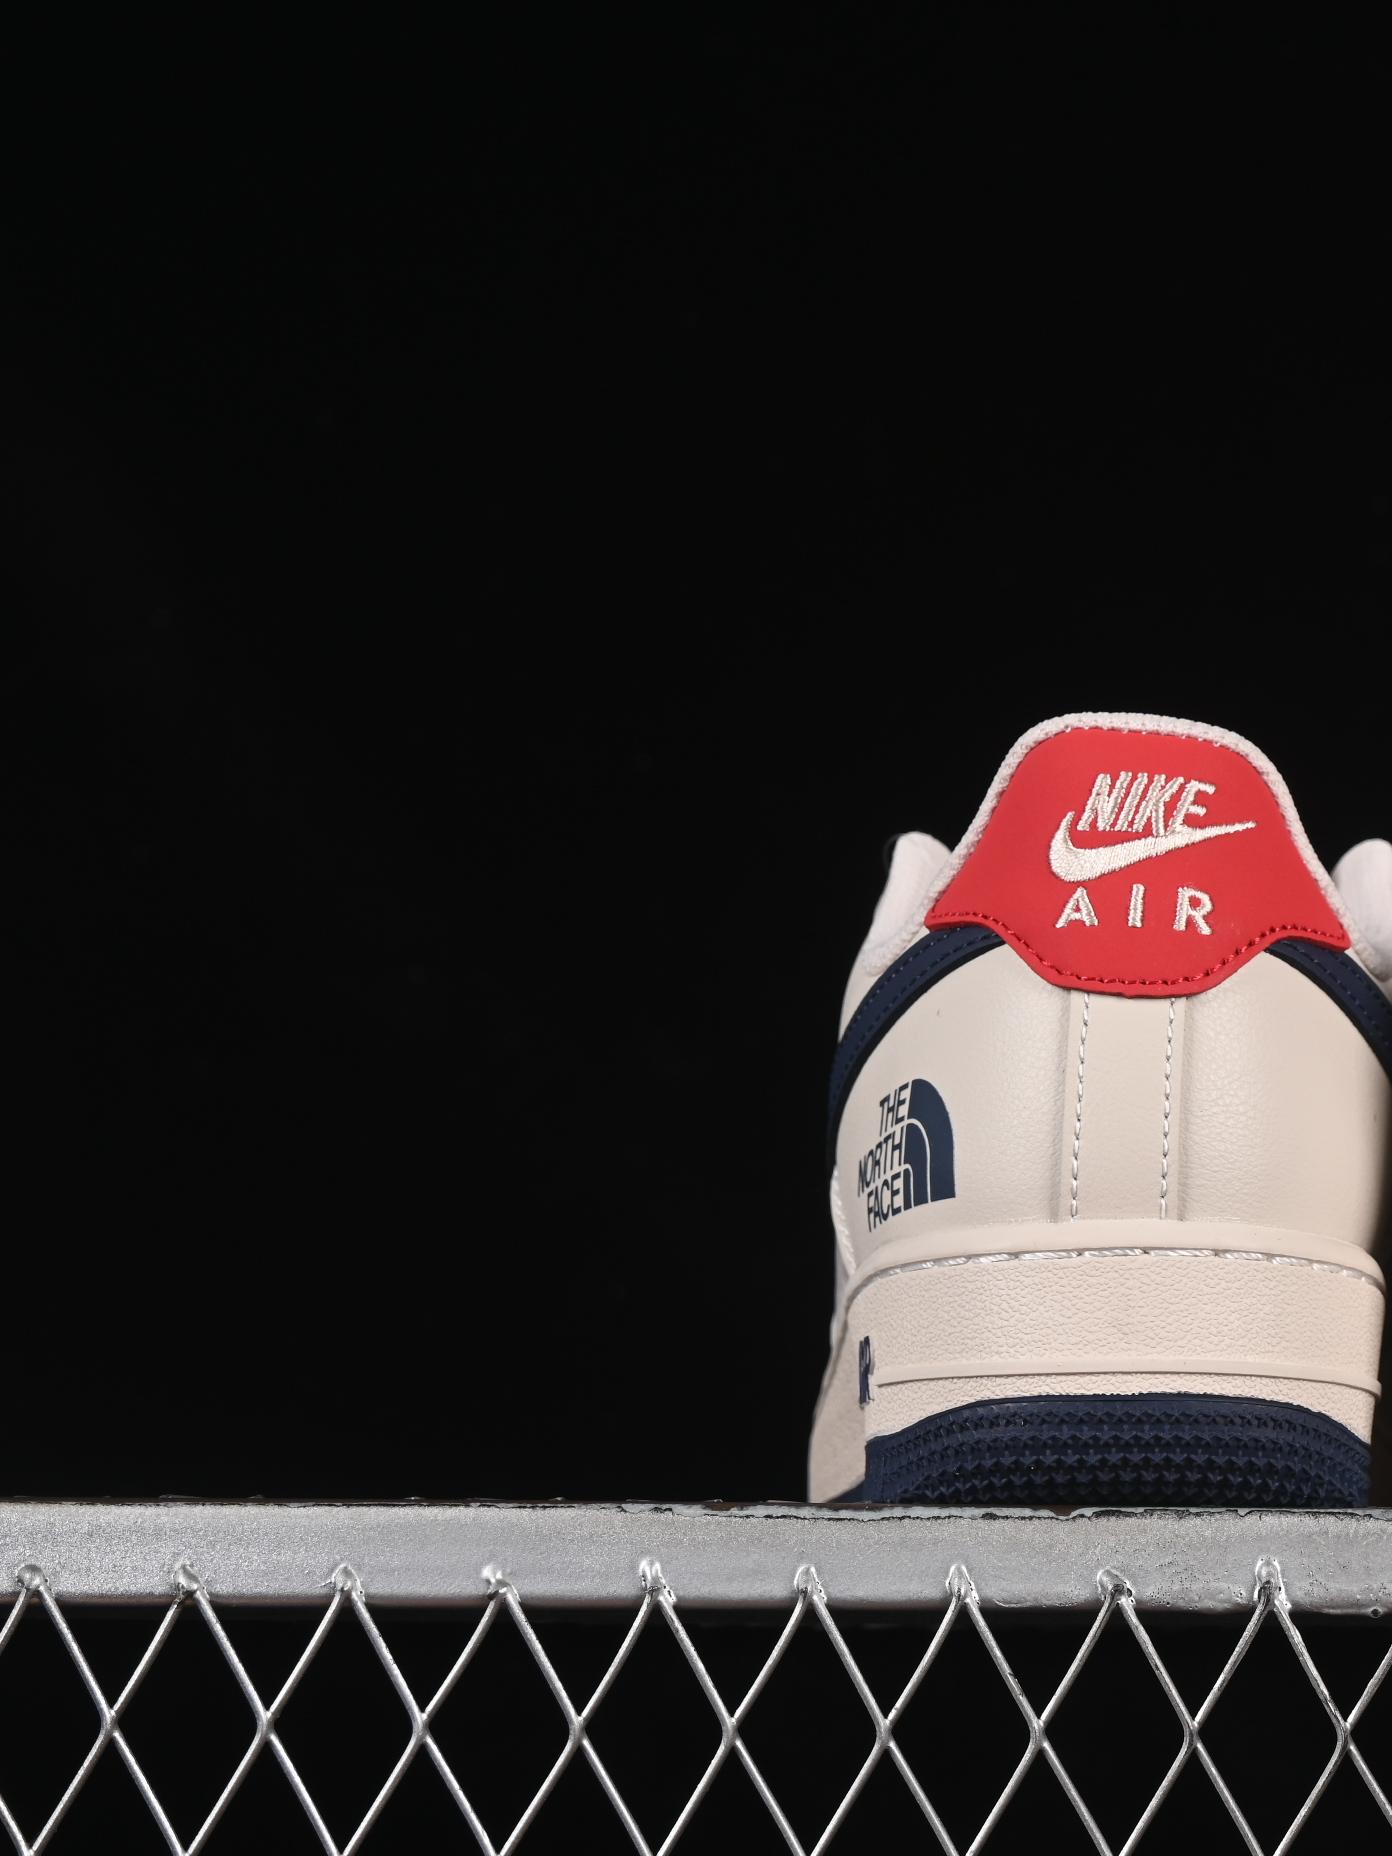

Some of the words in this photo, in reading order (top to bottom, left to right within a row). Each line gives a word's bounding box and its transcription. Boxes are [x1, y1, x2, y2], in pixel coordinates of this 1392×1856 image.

[1077, 771, 1216, 837] NIKE
[1055, 884, 1214, 935] AIR
[879, 1081, 910, 1137] THE
[857, 1125, 905, 1198] NORTH
[867, 1171, 902, 1233] FACE
